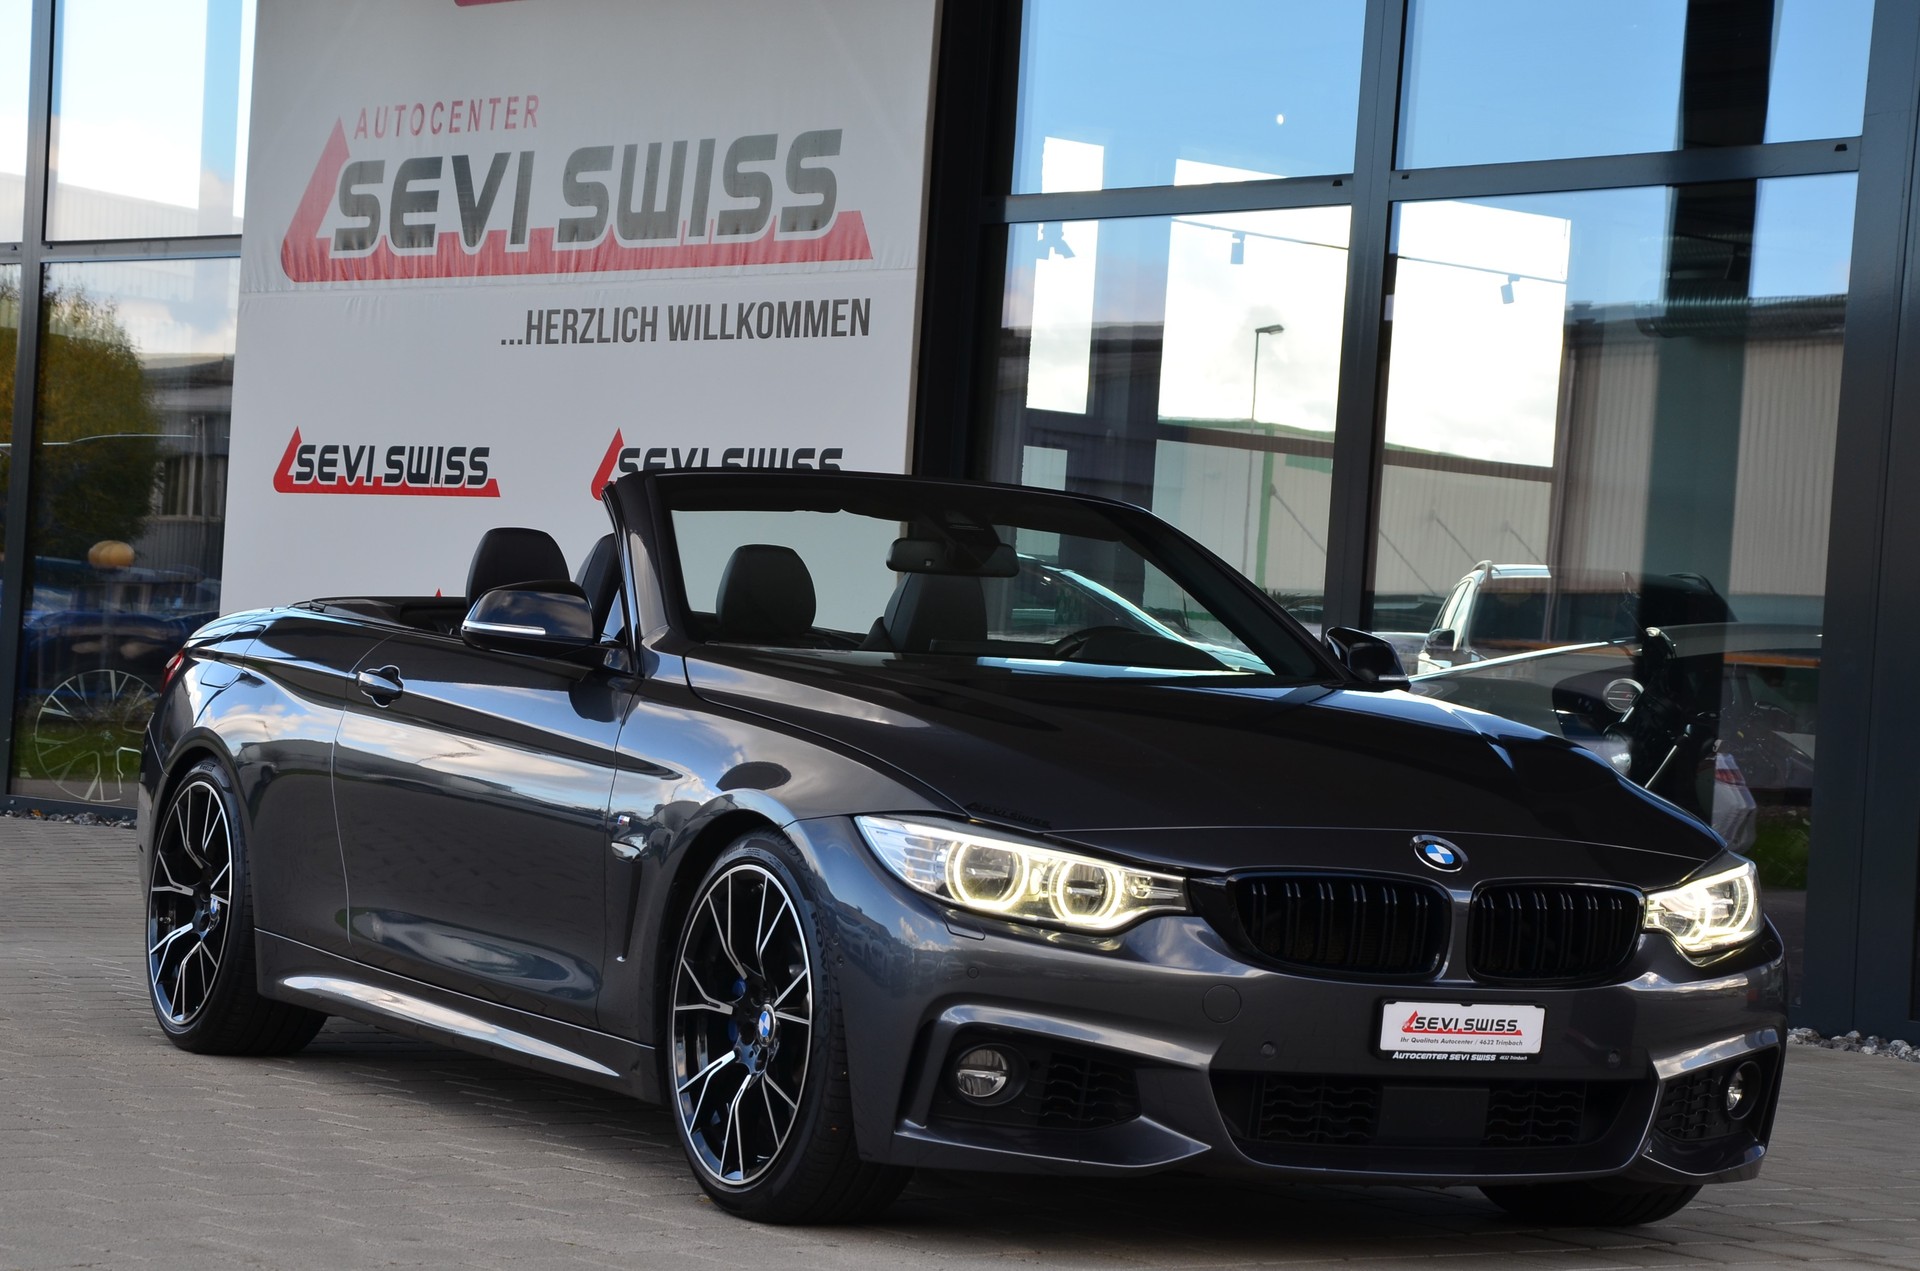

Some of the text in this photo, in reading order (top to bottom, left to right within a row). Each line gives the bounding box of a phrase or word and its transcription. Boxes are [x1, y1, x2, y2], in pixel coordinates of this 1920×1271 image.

[354, 94, 540, 140] AUTOCENTER
[333, 129, 843, 252] SEVI SWISS
[500, 297, 871, 346] ...HERZLICH WILLKOMMEN
[295, 444, 490, 486] SEVI SWISS
[1414, 1016, 1518, 1031] SEVI SWISS
[1448, 1053, 1470, 1061] SEVI
[1470, 1054, 1497, 1062] SWISS
